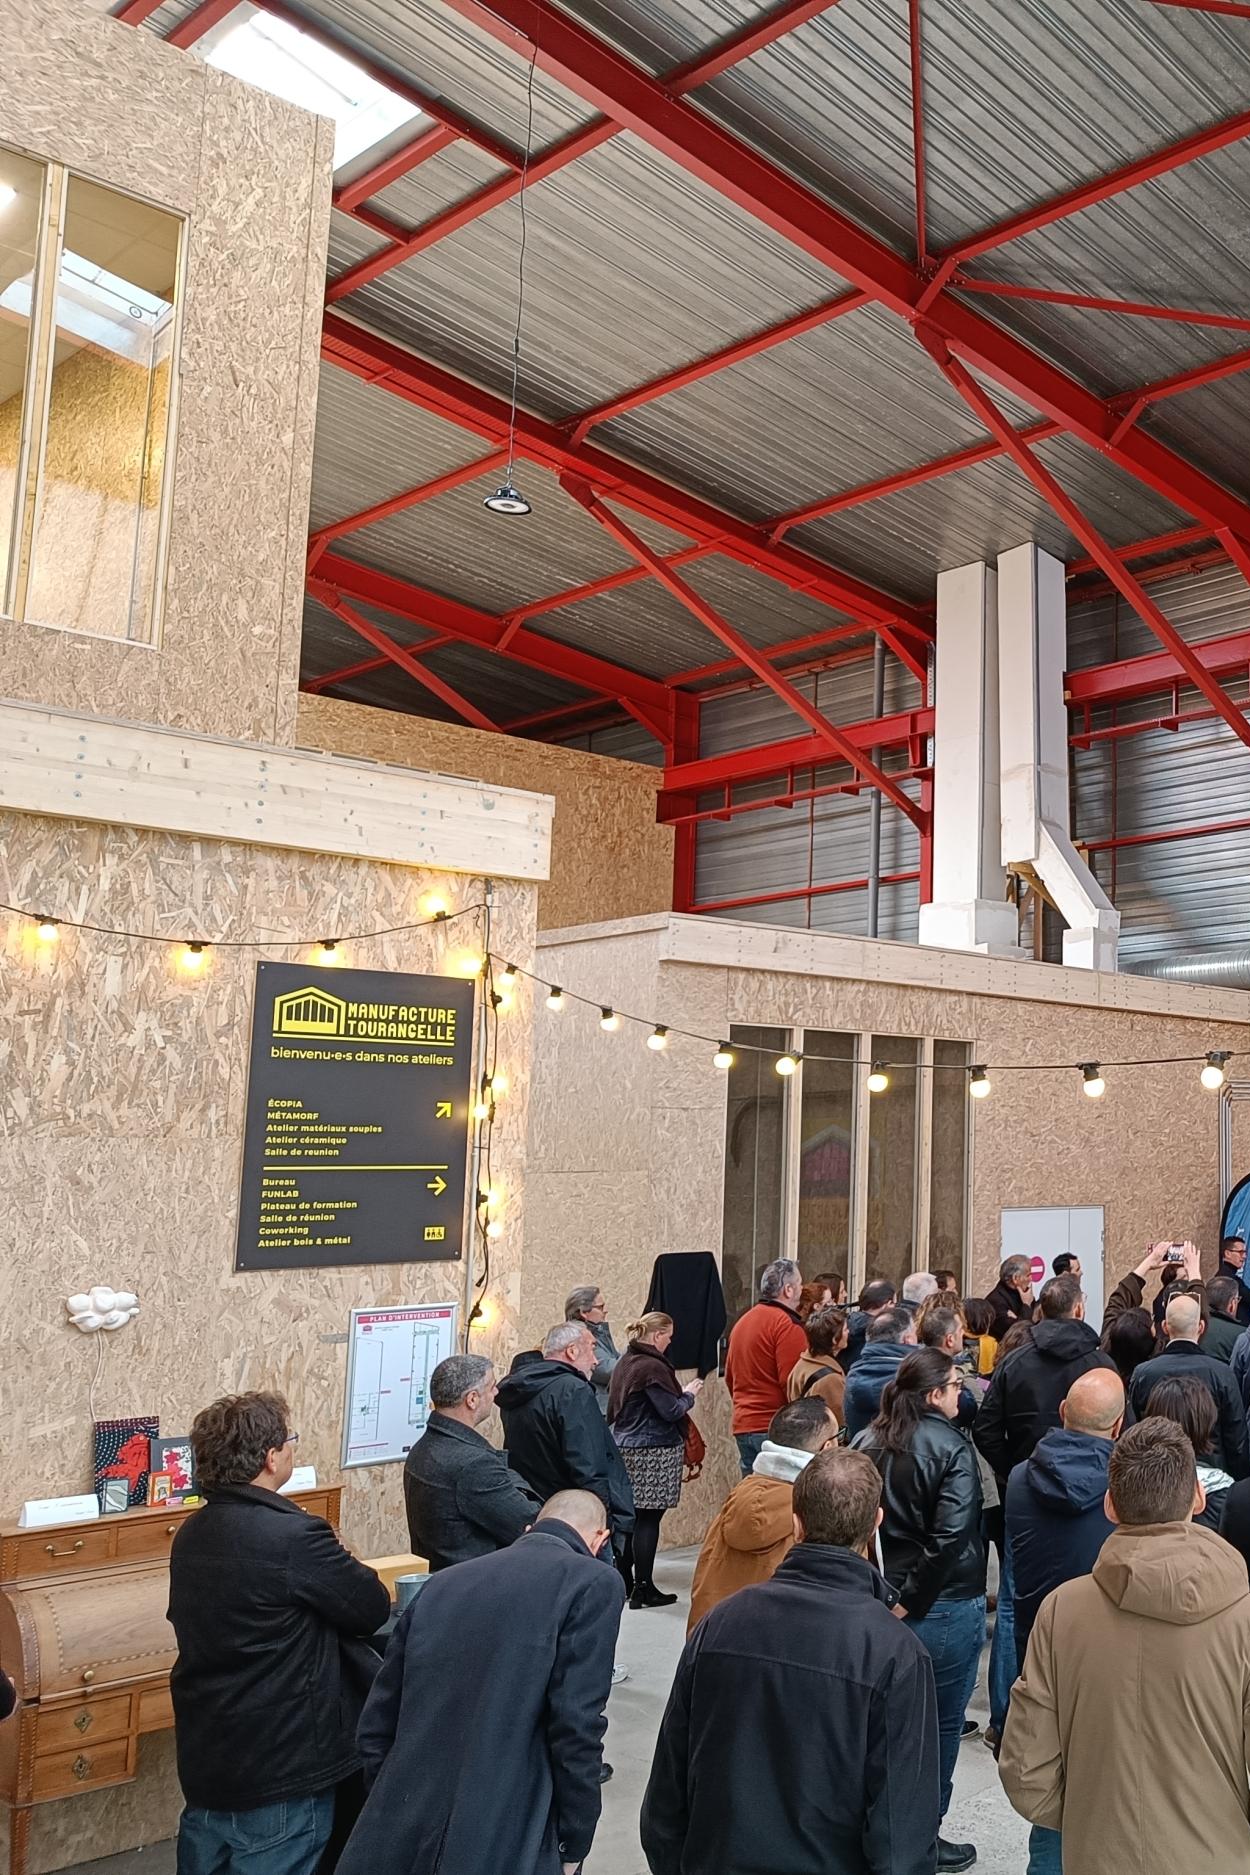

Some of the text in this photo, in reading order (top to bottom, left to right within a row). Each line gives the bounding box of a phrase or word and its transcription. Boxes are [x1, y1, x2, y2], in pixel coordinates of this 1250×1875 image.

[348, 1002, 456, 1024] MANUFACTURE
[355, 1051, 385, 1062] dans
[388, 1054, 408, 1063] nos
[411, 1054, 453, 1065] ateliers
[268, 1098, 303, 1108] ÉCOPIA
[265, 1124, 382, 1134] Atelier matériaux souples
[265, 1136, 347, 1145] Atelier céramique
[264, 1148, 288, 1156] Salle
[290, 1148, 301, 1156] de
[262, 1178, 296, 1186] Bureau
[261, 1190, 299, 1198] FUNLAB
[261, 1202, 296, 1210] Plateau
[313, 1201, 358, 1209] formation
[260, 1213, 335, 1222] Salle de réunion
[259, 1226, 309, 1235] Coworking
[258, 1239, 291, 1247] Atelier
[293, 1238, 313, 1246] bois
[324, 1236, 351, 1244] métal
[388, 1311, 440, 1321] D'INTERVENTION
